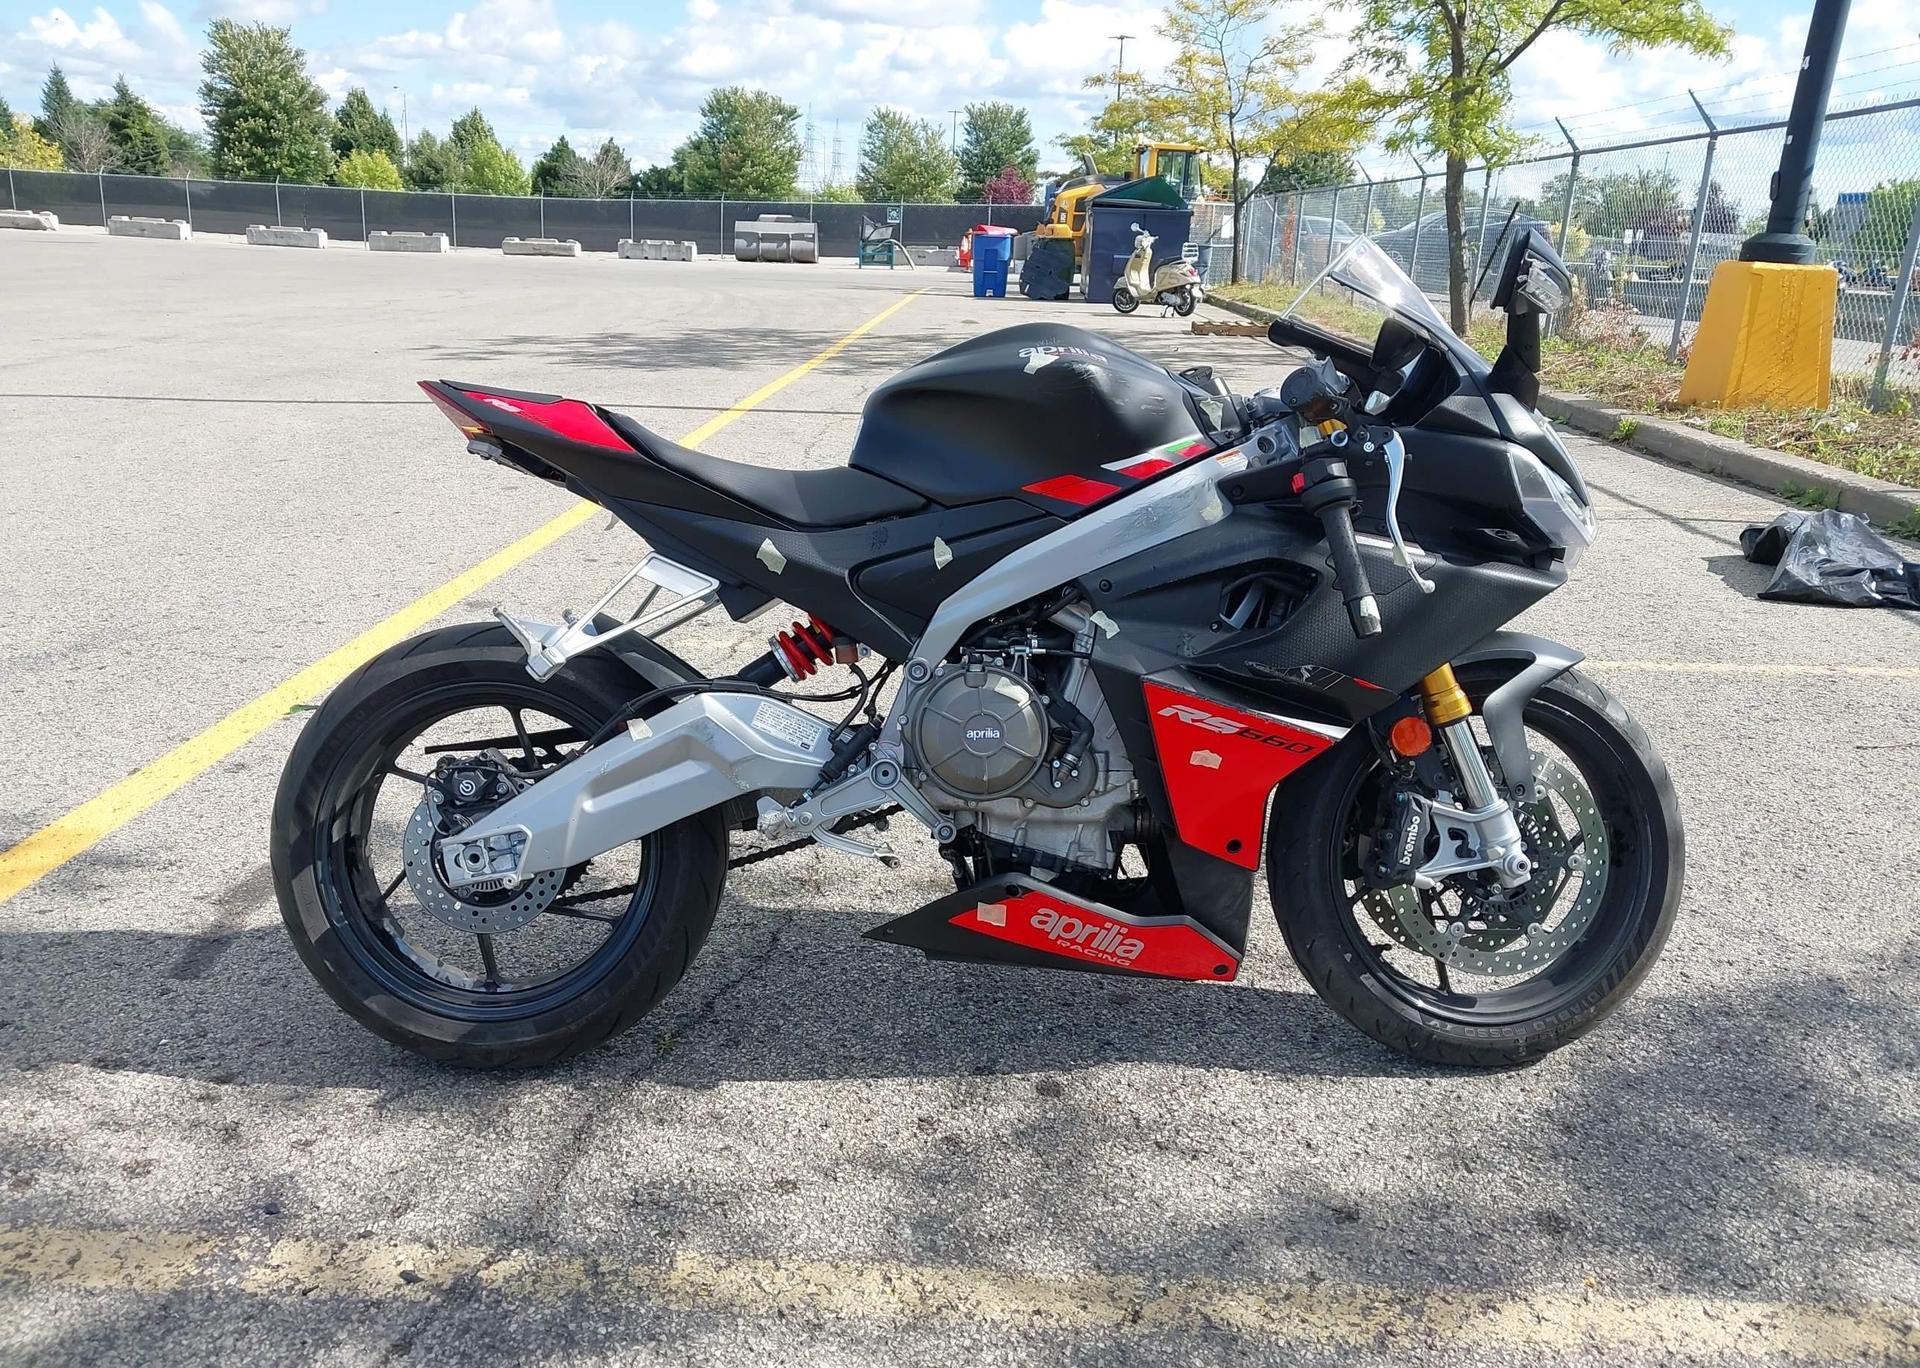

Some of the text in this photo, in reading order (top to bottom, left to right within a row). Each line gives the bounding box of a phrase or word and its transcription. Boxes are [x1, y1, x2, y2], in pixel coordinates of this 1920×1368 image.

[966, 727, 1000, 741] aprilia
[1399, 815, 1421, 866] brembo
[1030, 907, 1145, 960] aprilia
[1057, 939, 1132, 966] RACING
